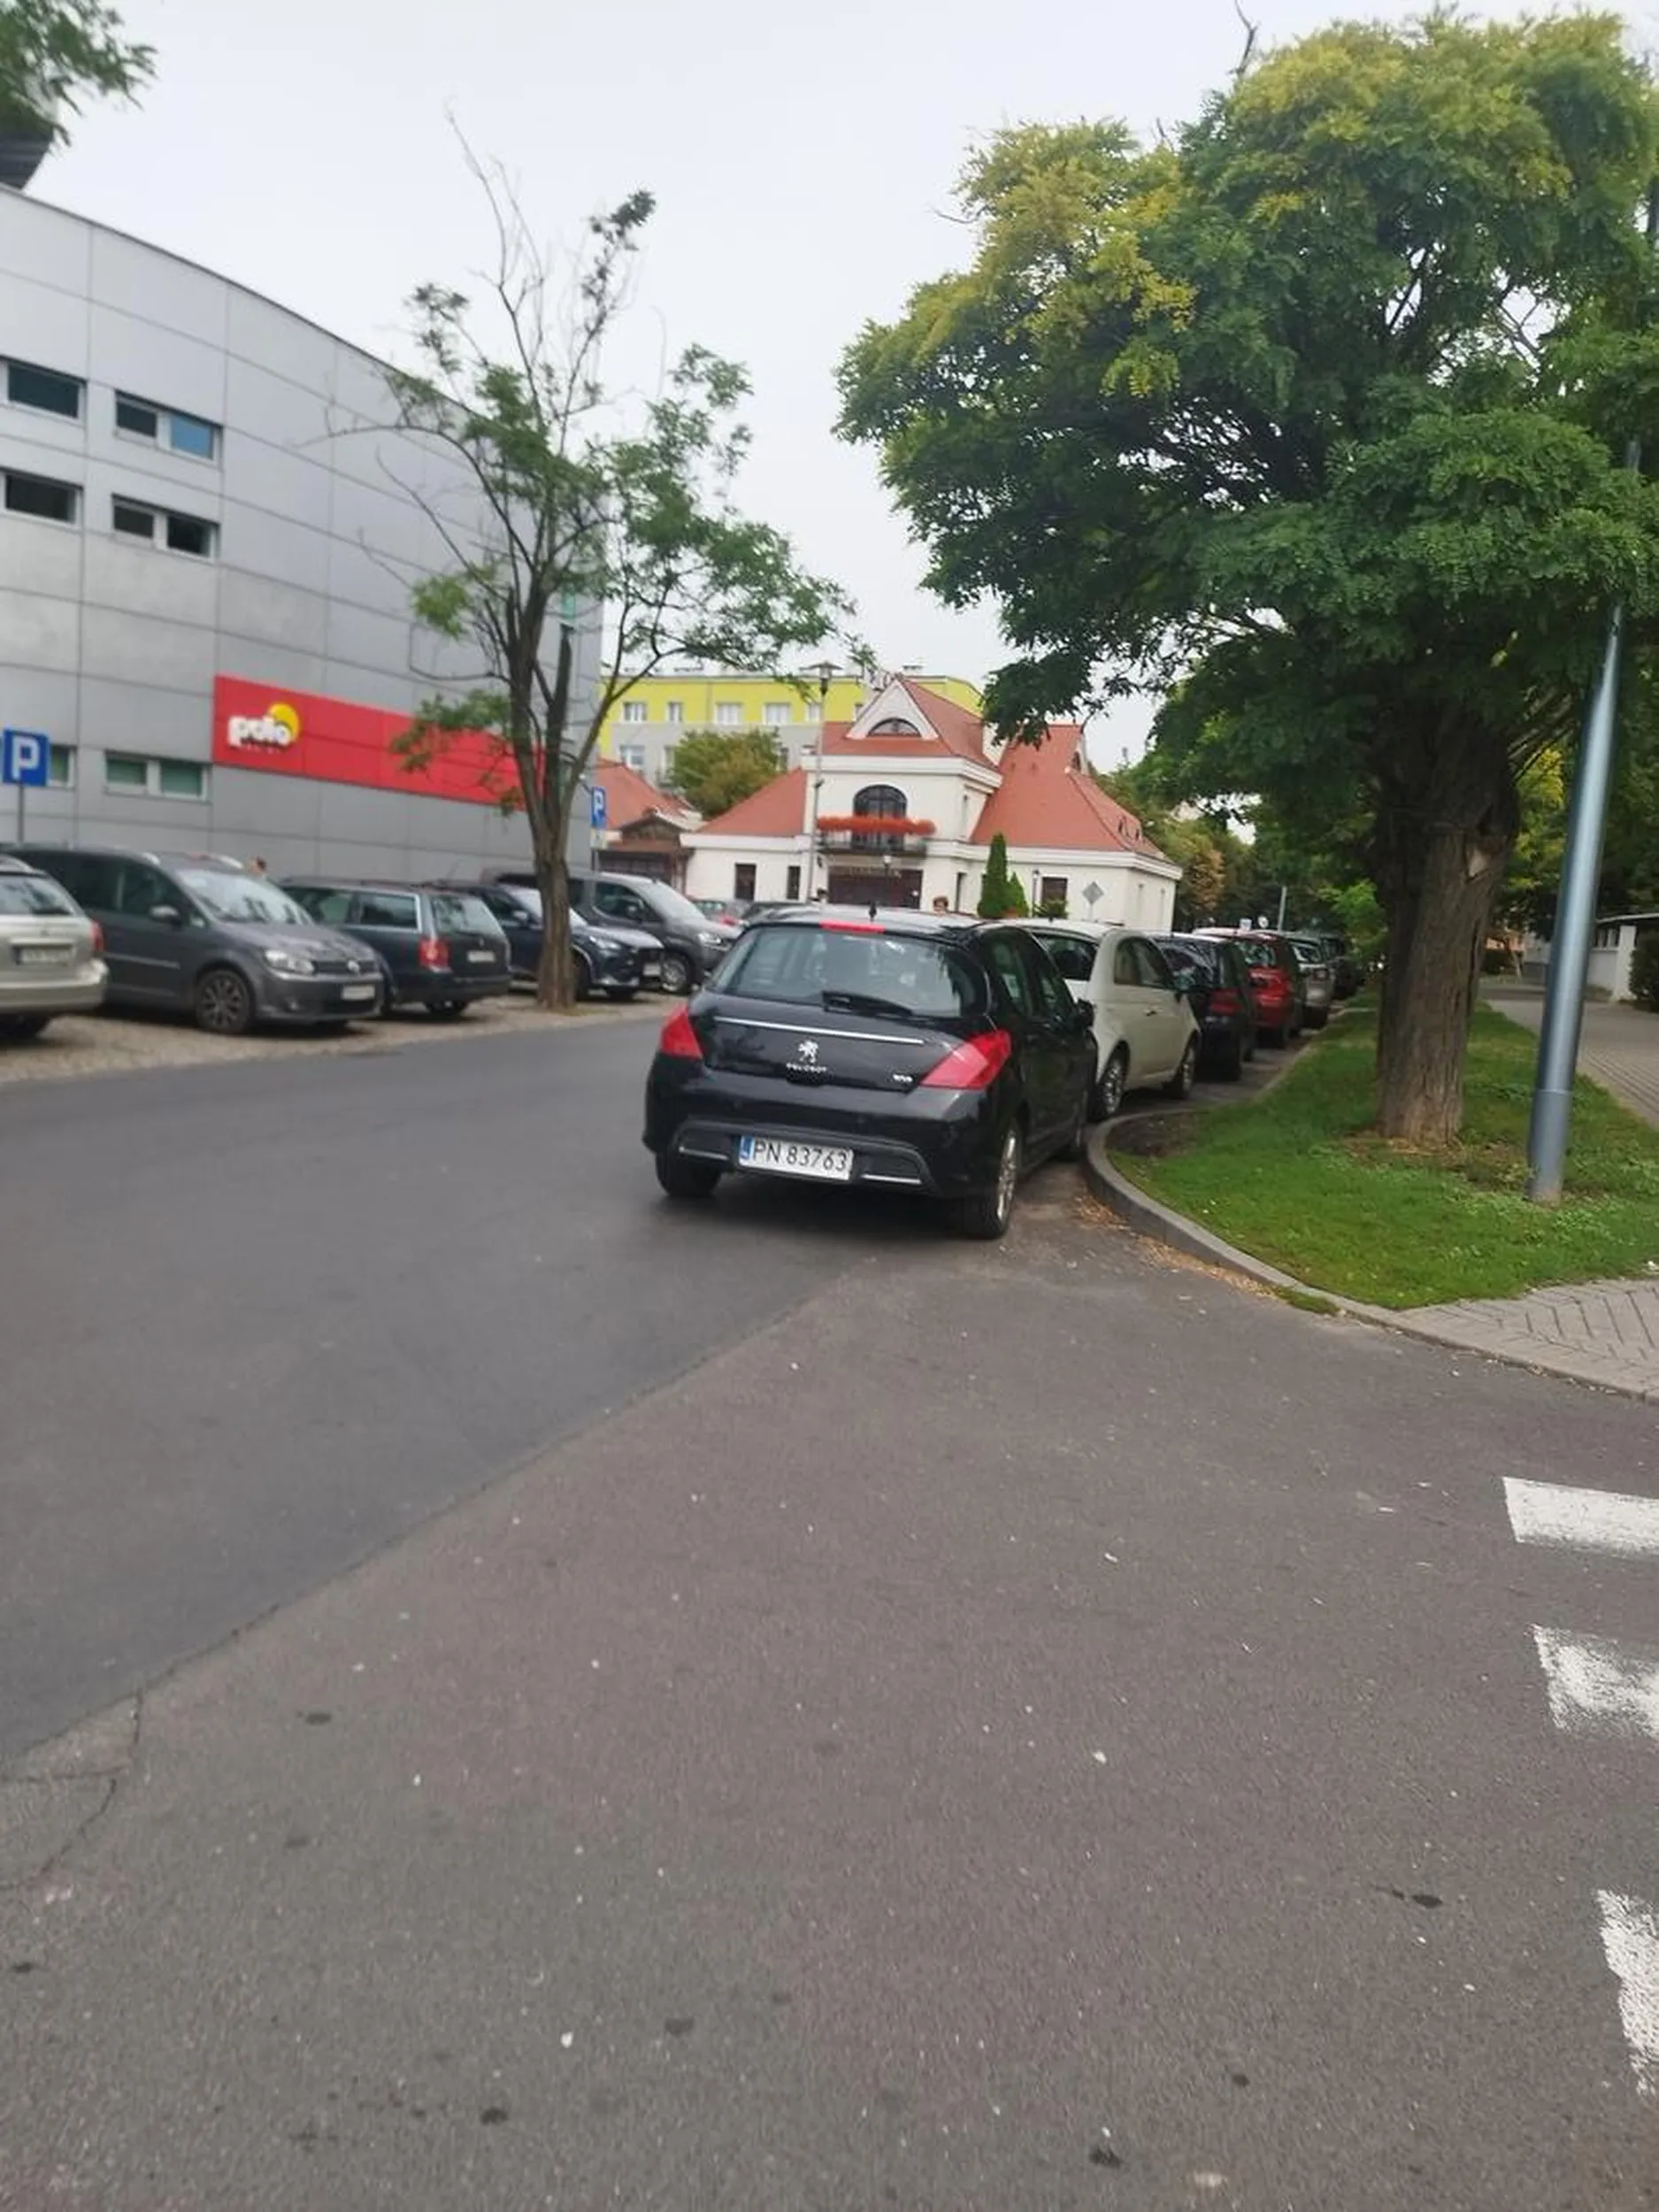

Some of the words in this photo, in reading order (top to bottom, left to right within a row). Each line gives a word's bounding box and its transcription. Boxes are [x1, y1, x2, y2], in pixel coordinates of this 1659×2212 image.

[228, 715, 292, 747] polo
[12, 735, 41, 780] P
[593, 789, 604, 821] P
[753, 1138, 781, 1164] PN
[786, 1145, 848, 1172] 83763
